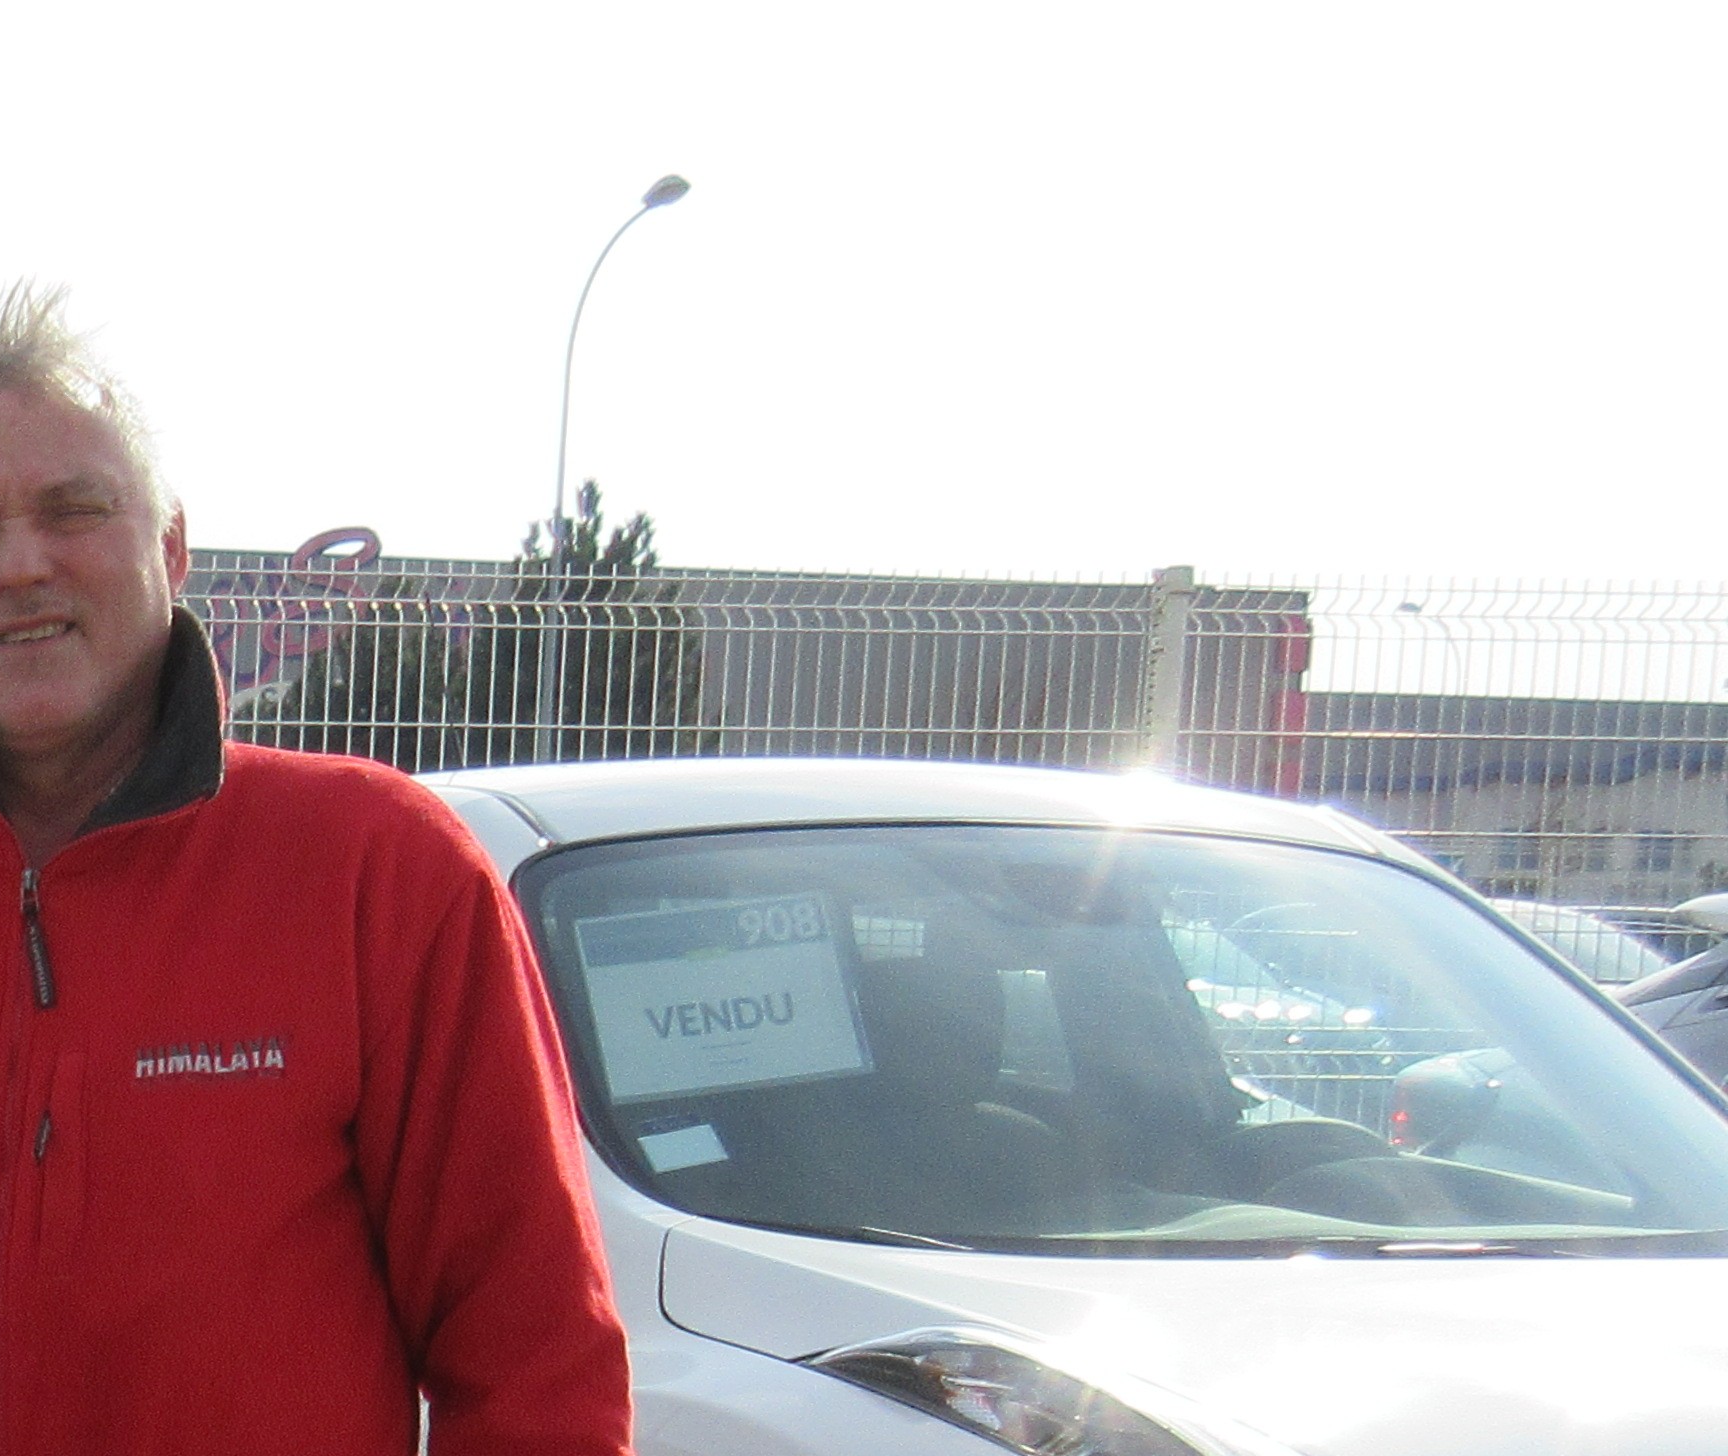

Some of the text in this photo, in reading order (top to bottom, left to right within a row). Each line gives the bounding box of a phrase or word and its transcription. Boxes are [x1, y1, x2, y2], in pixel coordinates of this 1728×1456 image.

[738, 902, 821, 945] 908
[645, 992, 794, 1039] VENDU
[134, 1035, 286, 1079] HIMALAYA
